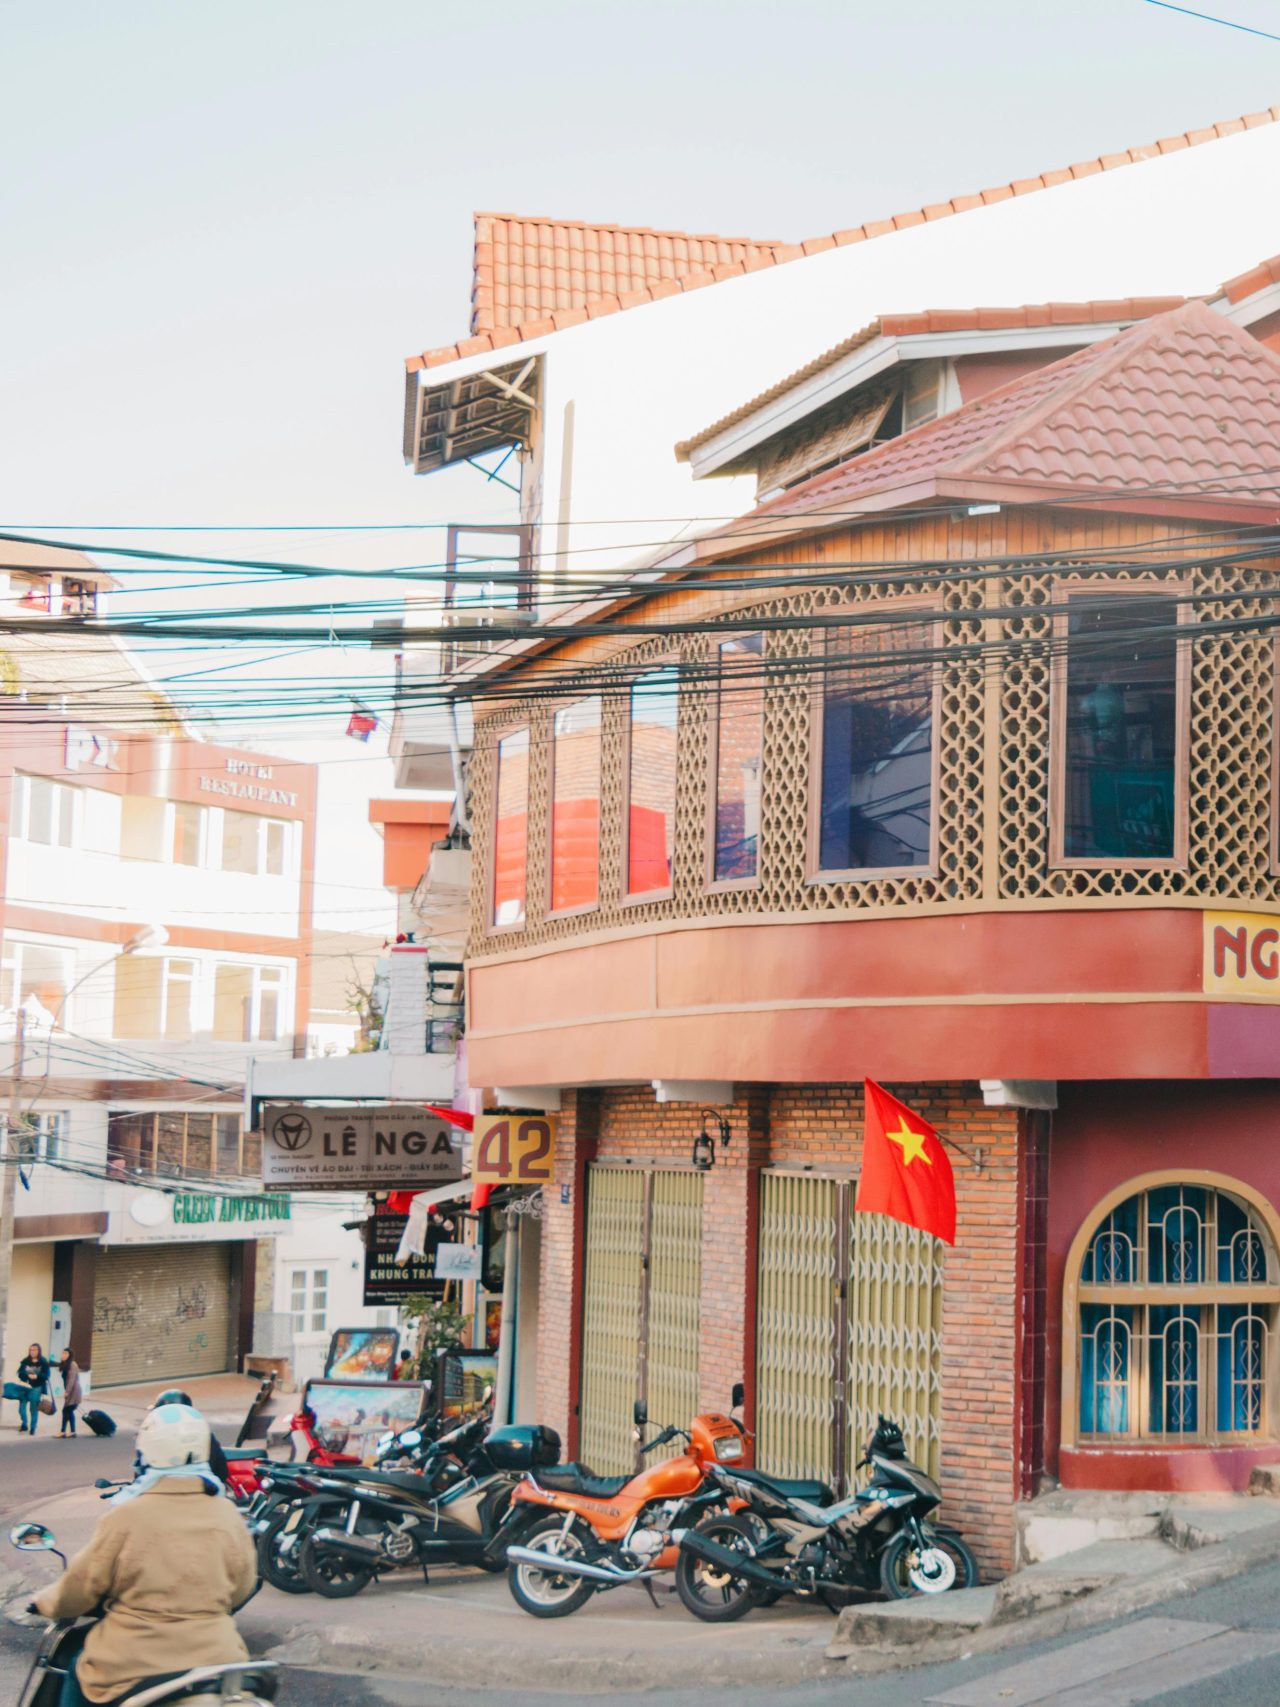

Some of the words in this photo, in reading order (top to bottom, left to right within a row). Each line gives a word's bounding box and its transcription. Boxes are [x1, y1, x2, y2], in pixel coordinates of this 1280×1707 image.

[199, 775, 299, 807] RESTAURANT
[323, 1125, 357, 1157] LÊ
[375, 1130, 454, 1156] NGA
[477, 1120, 551, 1178] 42
[173, 1193, 215, 1224] GREEN
[370, 1268, 409, 1280] KHUNG
